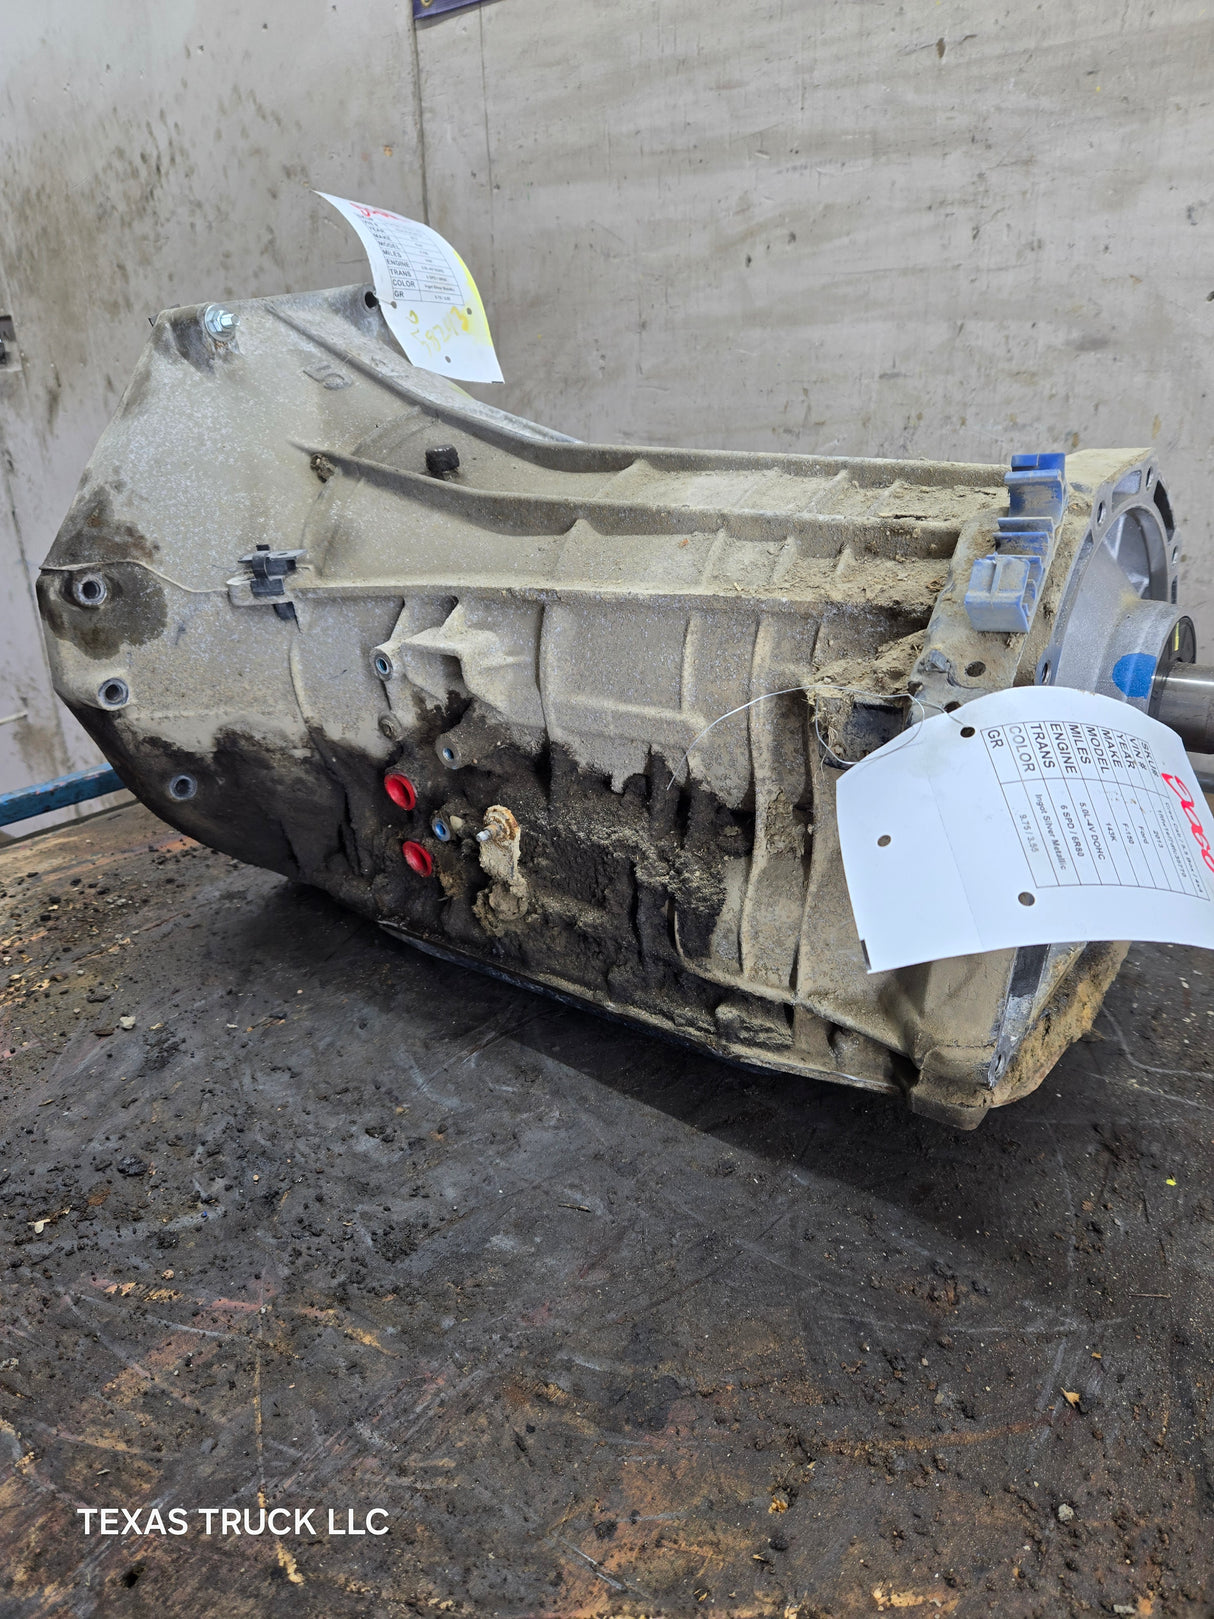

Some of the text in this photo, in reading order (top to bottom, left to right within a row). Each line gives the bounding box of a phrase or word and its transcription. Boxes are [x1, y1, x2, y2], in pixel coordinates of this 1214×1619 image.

[378, 241, 400, 250] MODEL
[382, 249, 402, 258] MILES
[386, 258, 410, 268] ENGINE
[390, 268, 412, 277] TRANS
[392, 279, 415, 288] COLOR
[394, 290, 404, 298] GR
[987, 729, 1004, 749] GR
[1009, 725, 1036, 772] COLOR
[1030, 723, 1055, 769] TRANS
[1050, 723, 1077, 774] ENGINE
[1069, 724, 1091, 764] MILES
[1086, 726, 1110, 774] MODEL
[1101, 729, 1123, 769] MAKE
[1116, 734, 1136, 770] YEAR
[1131, 738, 1142, 758] VIN
[1035, 793, 1066, 870] Ingot Silver Metallic
[1063, 812, 1075, 829] SPD
[1072, 836, 1084, 857] 6R80
[1091, 834, 1105, 860] DOHC
